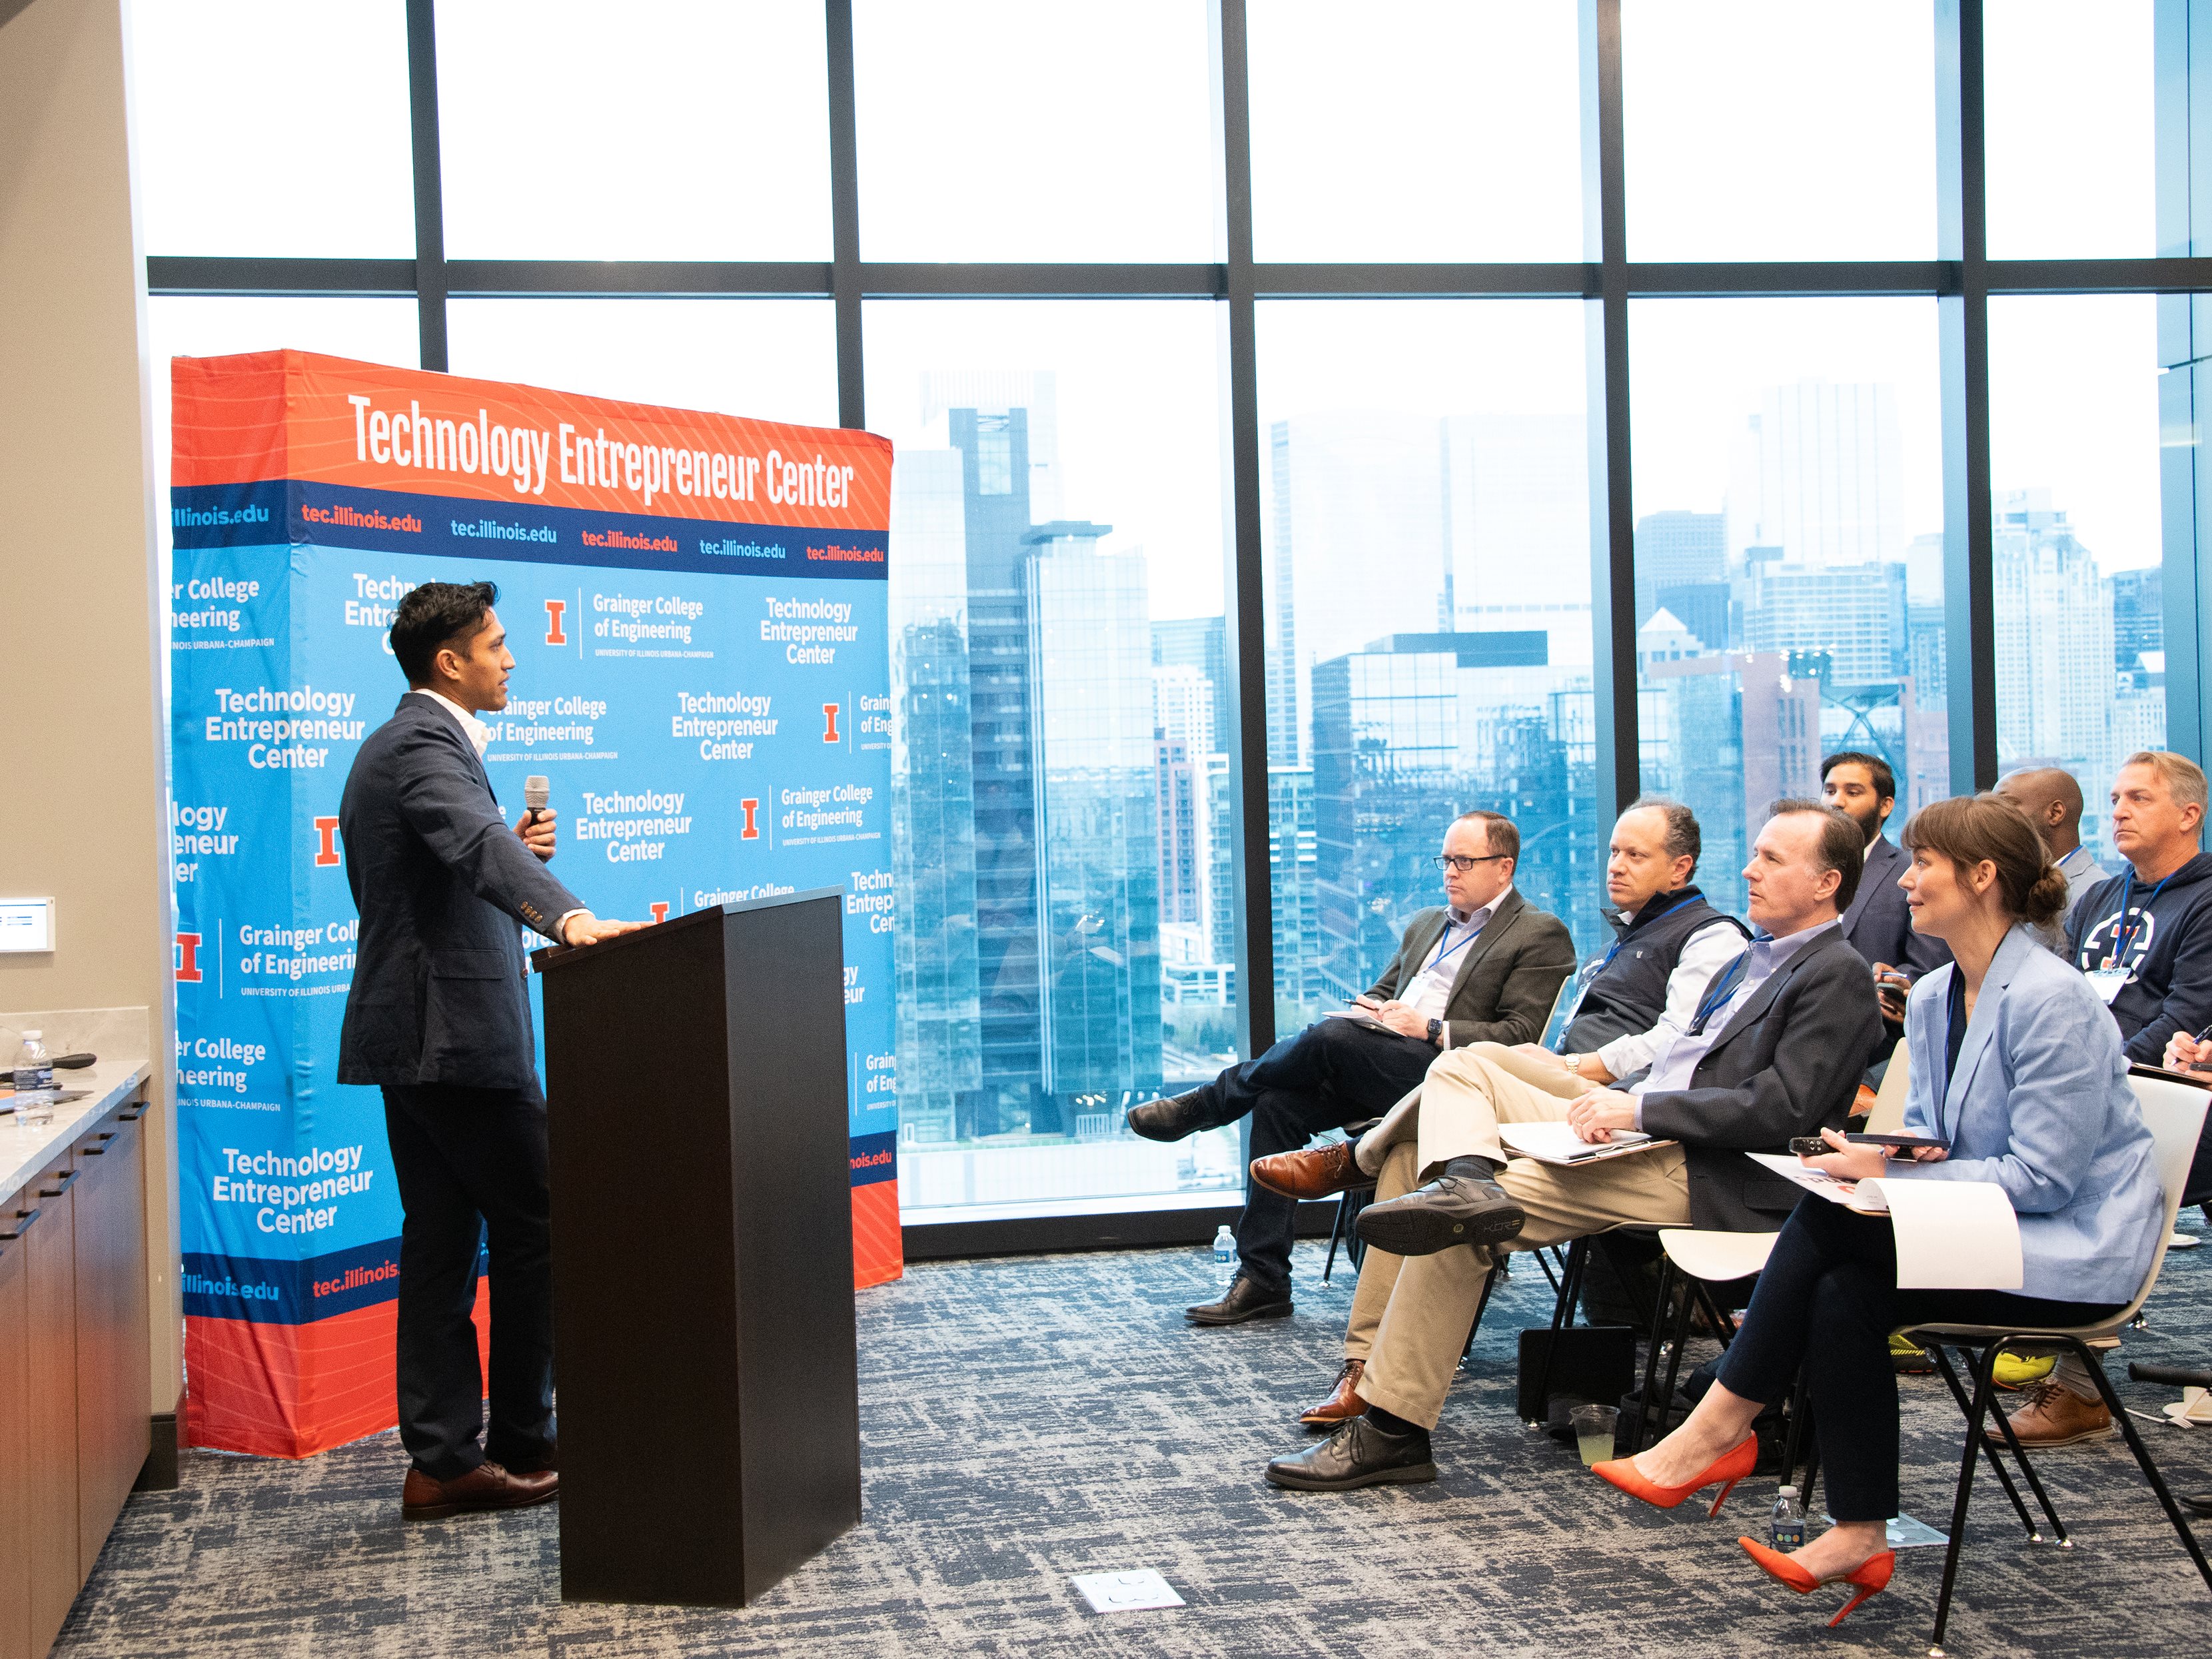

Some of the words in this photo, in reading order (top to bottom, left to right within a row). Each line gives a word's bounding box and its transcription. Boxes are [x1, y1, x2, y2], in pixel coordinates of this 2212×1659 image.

[348, 394, 550, 496] Technology
[559, 422, 760, 506] Entrepreneur
[766, 449, 853, 508] Center
[302, 504, 421, 532] tec.illinois.edu
[451, 520, 556, 543] tec.illinois.edu
[582, 530, 677, 552] tec.illinois.edu
[700, 539, 786, 558] tec.illinois.edu
[806, 545, 883, 562] tec.illinois.edu
[188, 577, 259, 603] College
[594, 594, 652, 618] Grainger
[656, 595, 703, 618] College
[766, 597, 851, 623] Technology
[594, 618, 609, 636] of
[612, 619, 692, 644] Engineering
[761, 620, 857, 646] Entrepreneur
[172, 641, 193, 650] NOIS
[193, 638, 274, 649] URBANA-CHAMPAIGN
[787, 644, 835, 664] Center
[215, 684, 356, 718] Technology
[487, 695, 551, 720] ainger
[554, 696, 606, 720] College
[678, 692, 771, 716] Technology
[860, 694, 891, 713] Grain
[207, 717, 366, 744] Entrepreneur
[489, 722, 503, 742] of
[506, 721, 594, 746] Engineering
[672, 716, 778, 740] Entrepreneur
[861, 716, 872, 733] of
[249, 744, 328, 768] Center
[558, 752, 618, 760] URBANA-CHAMPAIGN
[700, 740, 753, 760] Center
[583, 790, 684, 815] Technology
[782, 787, 831, 808] Grainger
[833, 784, 873, 804] College
[173, 801, 228, 831] logy
[782, 810, 795, 828] of
[797, 806, 863, 830] Engineering
[576, 817, 692, 841] Entrepreneur
[175, 835, 239, 855] eneur
[607, 839, 665, 863] Center
[783, 837, 810, 846] UNIVERSITY
[177, 862, 199, 882] er
[851, 869, 893, 891] Techn
[694, 887, 749, 907] Grainger
[240, 924, 324, 951] Grainger
[241, 952, 262, 973] of
[288, 988, 300, 997] OF
[300, 985, 331, 995] ILLINOIS
[195, 1038, 265, 1065] College
[177, 1065, 247, 1093] neering
[866, 1075, 879, 1093] of
[200, 1099, 280, 1111] URBANA-CHAMPAIGN
[223, 1145, 362, 1177] Technology
[213, 1171, 373, 1210] Entrepreneur
[257, 1206, 337, 1233] Center
[183, 1273, 279, 1301] illinoisedu
